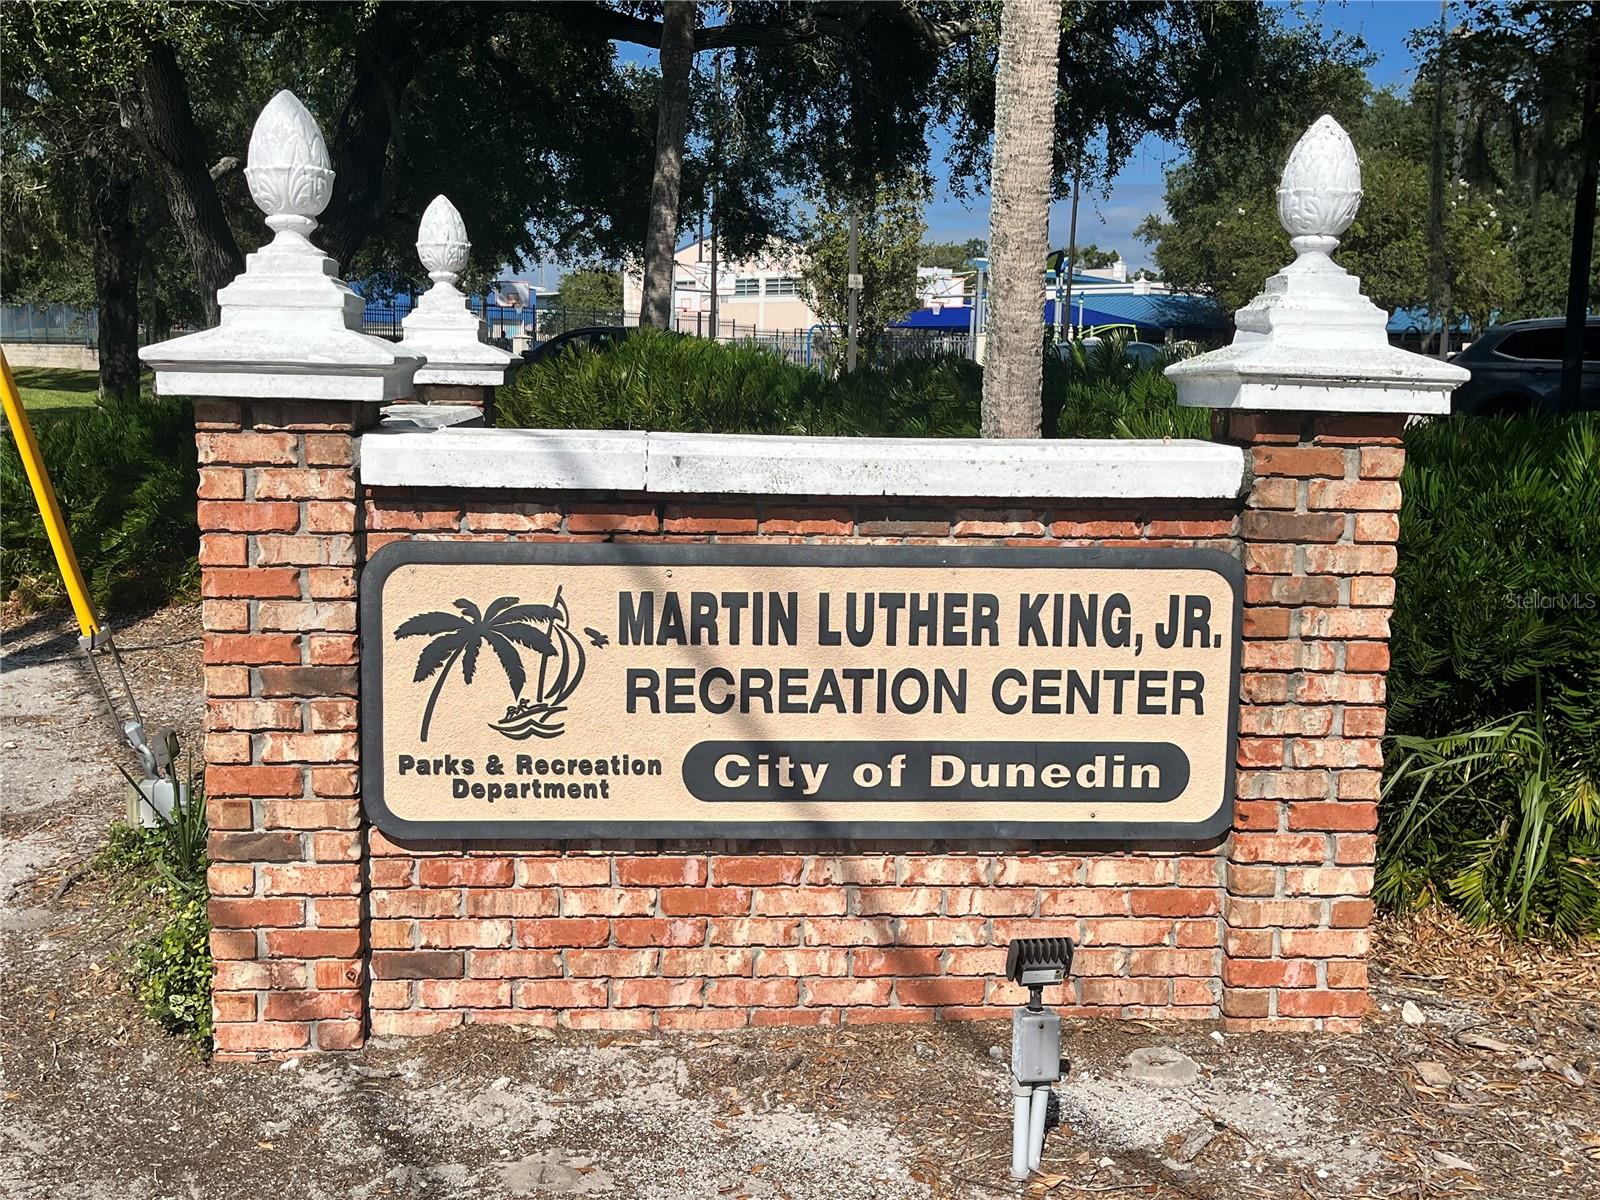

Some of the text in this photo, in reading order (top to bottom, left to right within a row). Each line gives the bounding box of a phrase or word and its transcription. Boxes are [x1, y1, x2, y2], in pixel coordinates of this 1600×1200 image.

[618, 591, 1222, 656] MARTIN LUTHER KING, JR.
[626, 667, 1205, 715] RECREATION CENTER
[398, 754, 662, 776] Parks & Recreation
[714, 753, 1161, 796] City of Dunedin
[452, 778, 610, 802] Department
